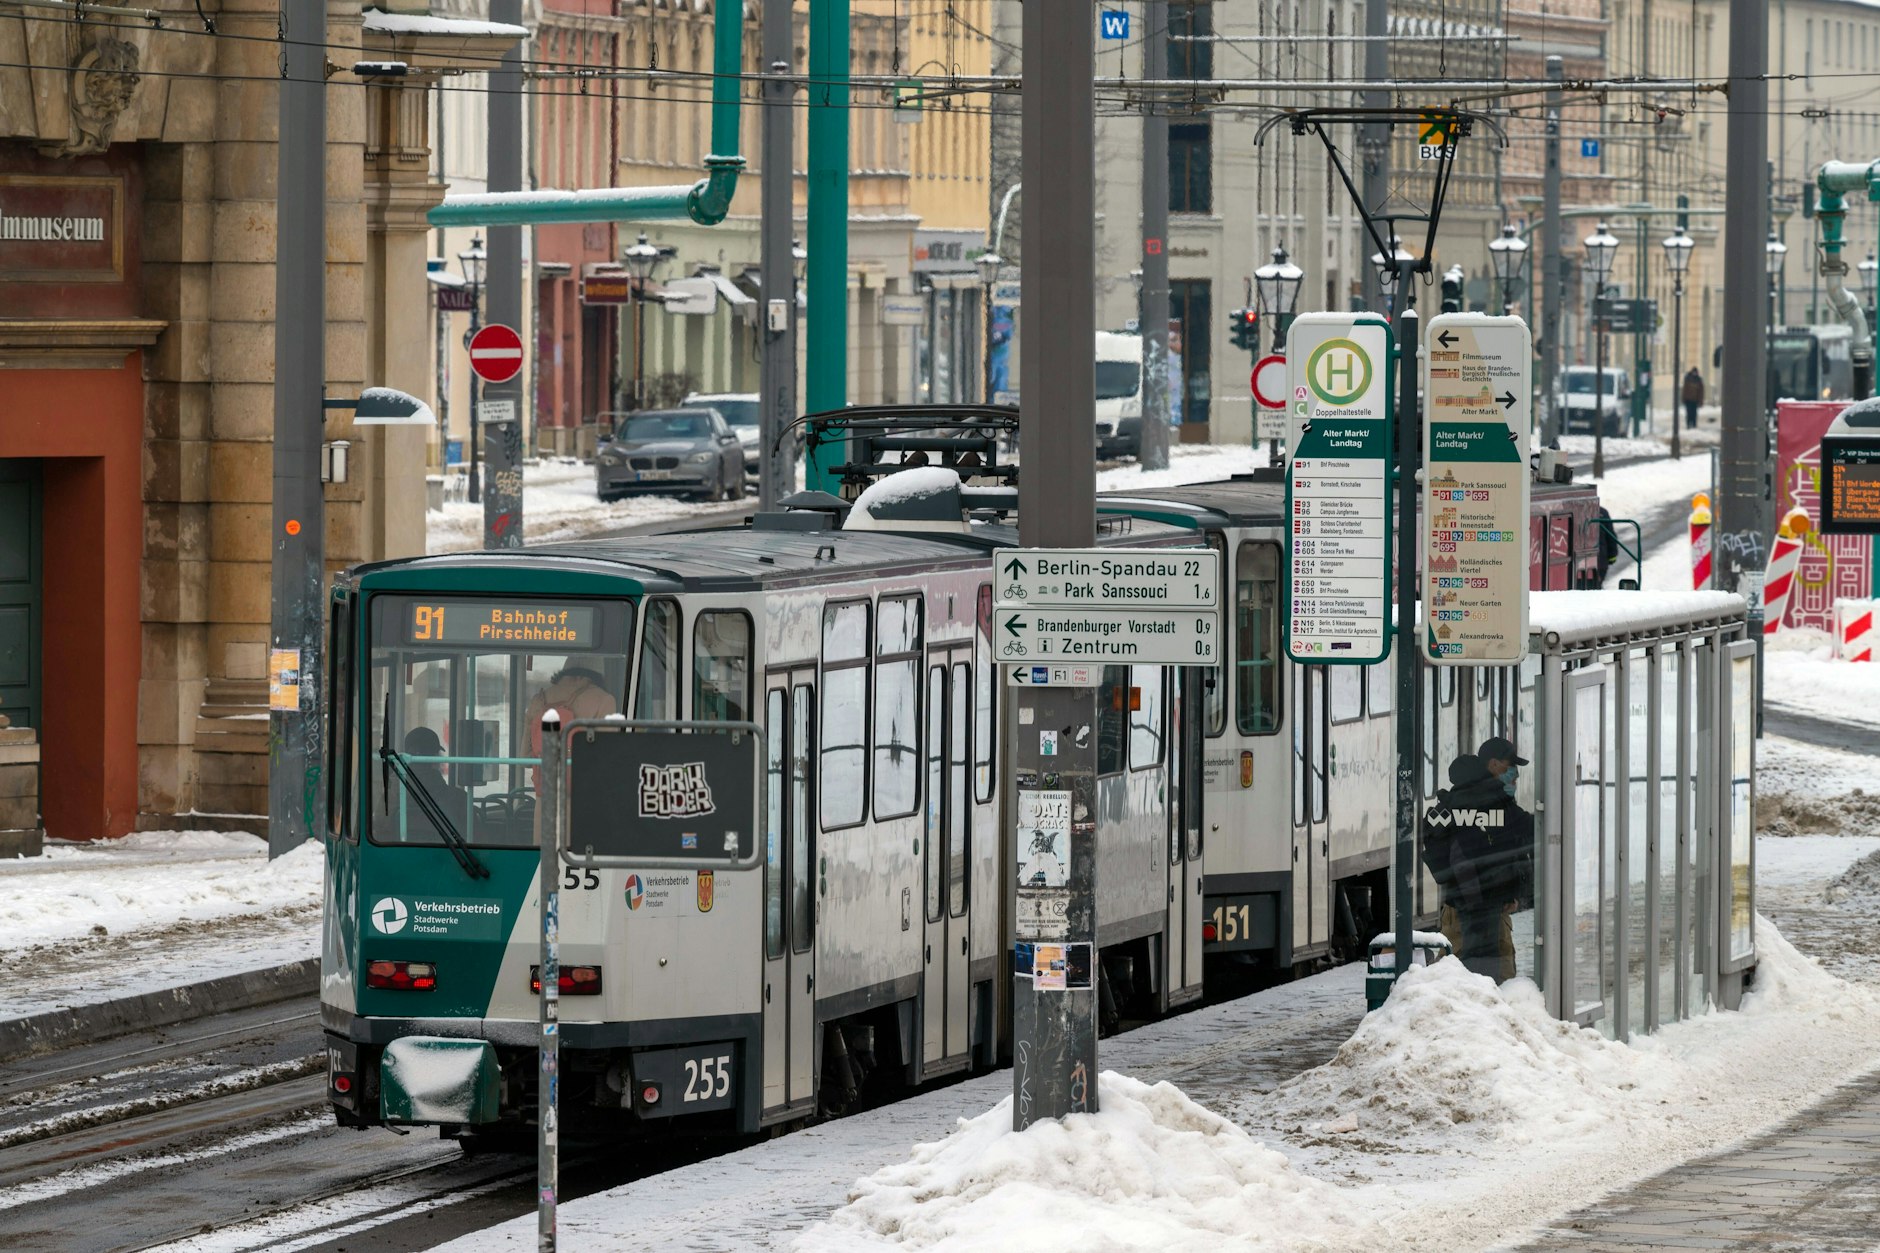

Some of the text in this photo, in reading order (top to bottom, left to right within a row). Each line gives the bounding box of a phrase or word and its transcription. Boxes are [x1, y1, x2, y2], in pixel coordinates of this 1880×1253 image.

[1104, 17, 1127, 36] W
[1421, 147, 1456, 159] BUS
[1326, 353, 1353, 391] H
[1315, 408, 1372, 417] Doppelhaltestelle
[1436, 431, 1484, 440] Alter Markt/
[1330, 440, 1363, 448] Landtag
[1436, 440, 1468, 449] Landtag
[1440, 491, 1488, 500] 91 98 695
[1440, 532, 1513, 540] 91 92 93 96 98 99
[1440, 543, 1455, 551] 695
[1038, 560, 1200, 579] Berlin-Spandau 22
[1440, 579, 1487, 587] 92 96 695
[1065, 582, 1094, 598] Park
[1102, 583, 1168, 599] Sanssouci
[1440, 611, 1487, 620] 92 96 603
[415, 606, 568, 640] 91 Bahnhof
[1038, 618, 1122, 636] Brandenburger
[1128, 619, 1176, 634] Vorstadt
[480, 624, 577, 641] Pirschheide
[1062, 638, 1138, 654] Zentrum
[1440, 645, 1462, 653] 92 96
[1452, 809, 1504, 828] Wall
[557, 866, 600, 890] 55
[646, 876, 690, 887] Verkehrsbetrieb
[646, 890, 669, 898] Stadtwerke
[414, 901, 500, 914] Verkehrsbetrieb
[646, 899, 664, 907] Potsdam
[413, 915, 459, 924] Stadtwerke
[1213, 905, 1250, 941] 151
[413, 925, 448, 933] Potsdam
[683, 1055, 730, 1102] 255
